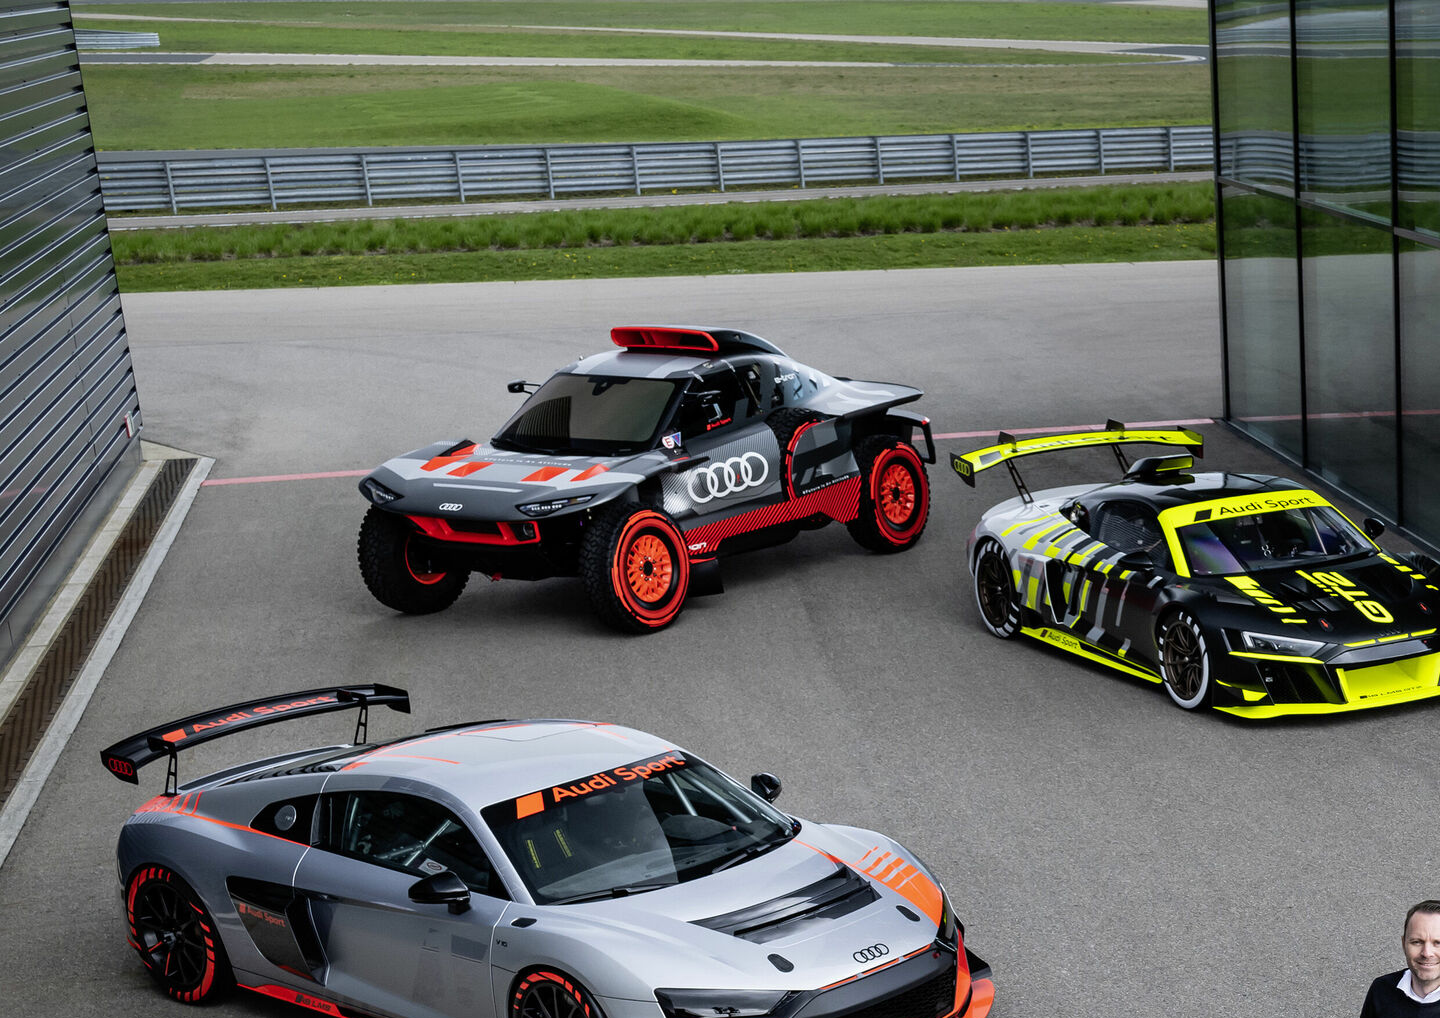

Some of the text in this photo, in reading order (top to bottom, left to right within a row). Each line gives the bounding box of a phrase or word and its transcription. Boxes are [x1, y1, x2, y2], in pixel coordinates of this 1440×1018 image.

[1220, 497, 1315, 515] Audi Sport
[1312, 571, 1394, 623] GT2
[1047, 631, 1078, 649] Audi Sport
[193, 696, 336, 733] Audi Sport
[551, 755, 686, 803] Audi Sport
[247, 905, 286, 928] Audi Sport
